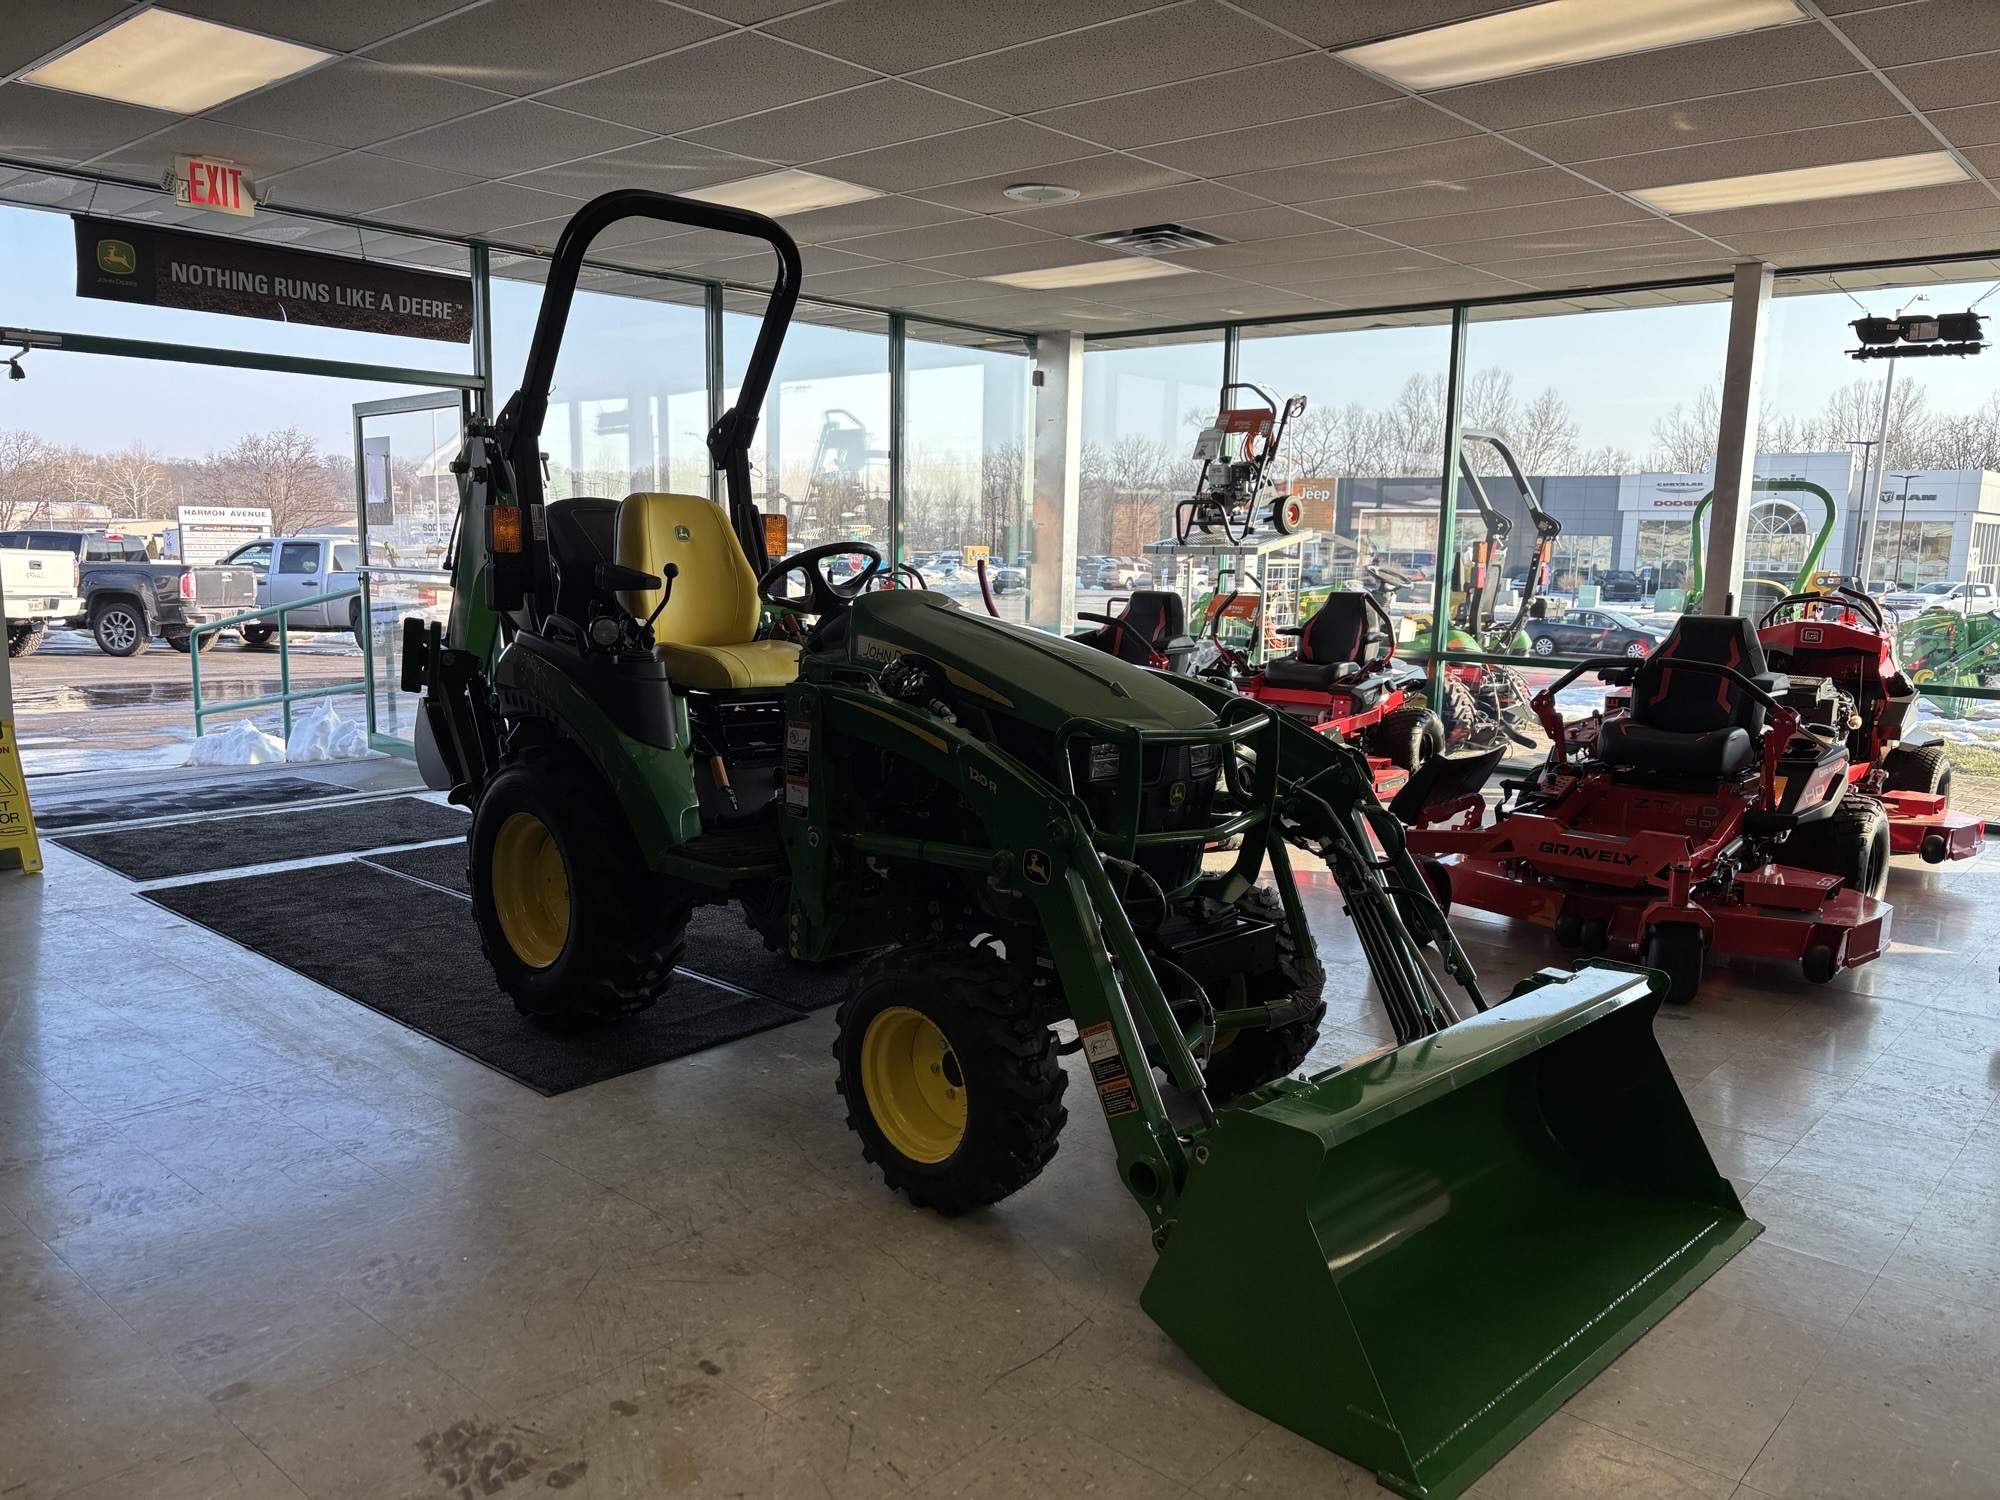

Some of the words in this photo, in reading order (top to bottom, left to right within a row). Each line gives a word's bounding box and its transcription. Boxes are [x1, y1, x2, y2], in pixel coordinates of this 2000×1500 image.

[189, 161, 242, 209] EXIT
[116, 278, 138, 287] DEERE
[171, 261, 268, 295] NOTHING
[275, 277, 330, 303] RUNS
[336, 286, 375, 310] LIKE
[381, 293, 394, 312] A
[1297, 487, 1331, 502] Jeep
[184, 509, 225, 517] HARMON
[230, 510, 267, 518] AVENUE
[862, 642, 892, 662] JOHN
[1804, 784, 1825, 803] HD
[1539, 841, 1640, 866] GRAVELY
